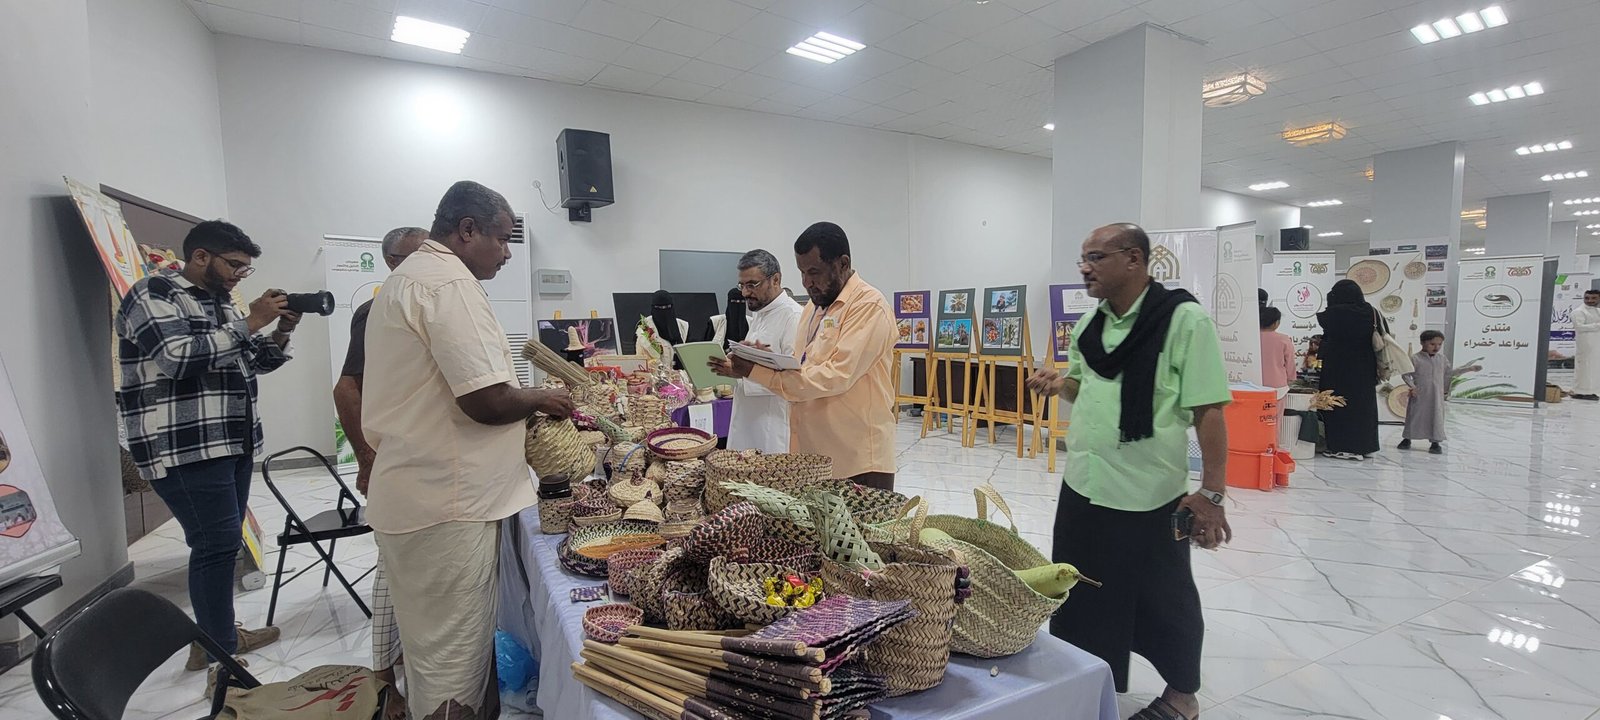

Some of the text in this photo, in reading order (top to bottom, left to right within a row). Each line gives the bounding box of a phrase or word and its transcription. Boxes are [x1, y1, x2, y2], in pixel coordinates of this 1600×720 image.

[1291, 320, 1317, 331] مؤسسة
[1481, 322, 1511, 333] منتدى
[1463, 337, 1529, 350] سواعد خضراء
